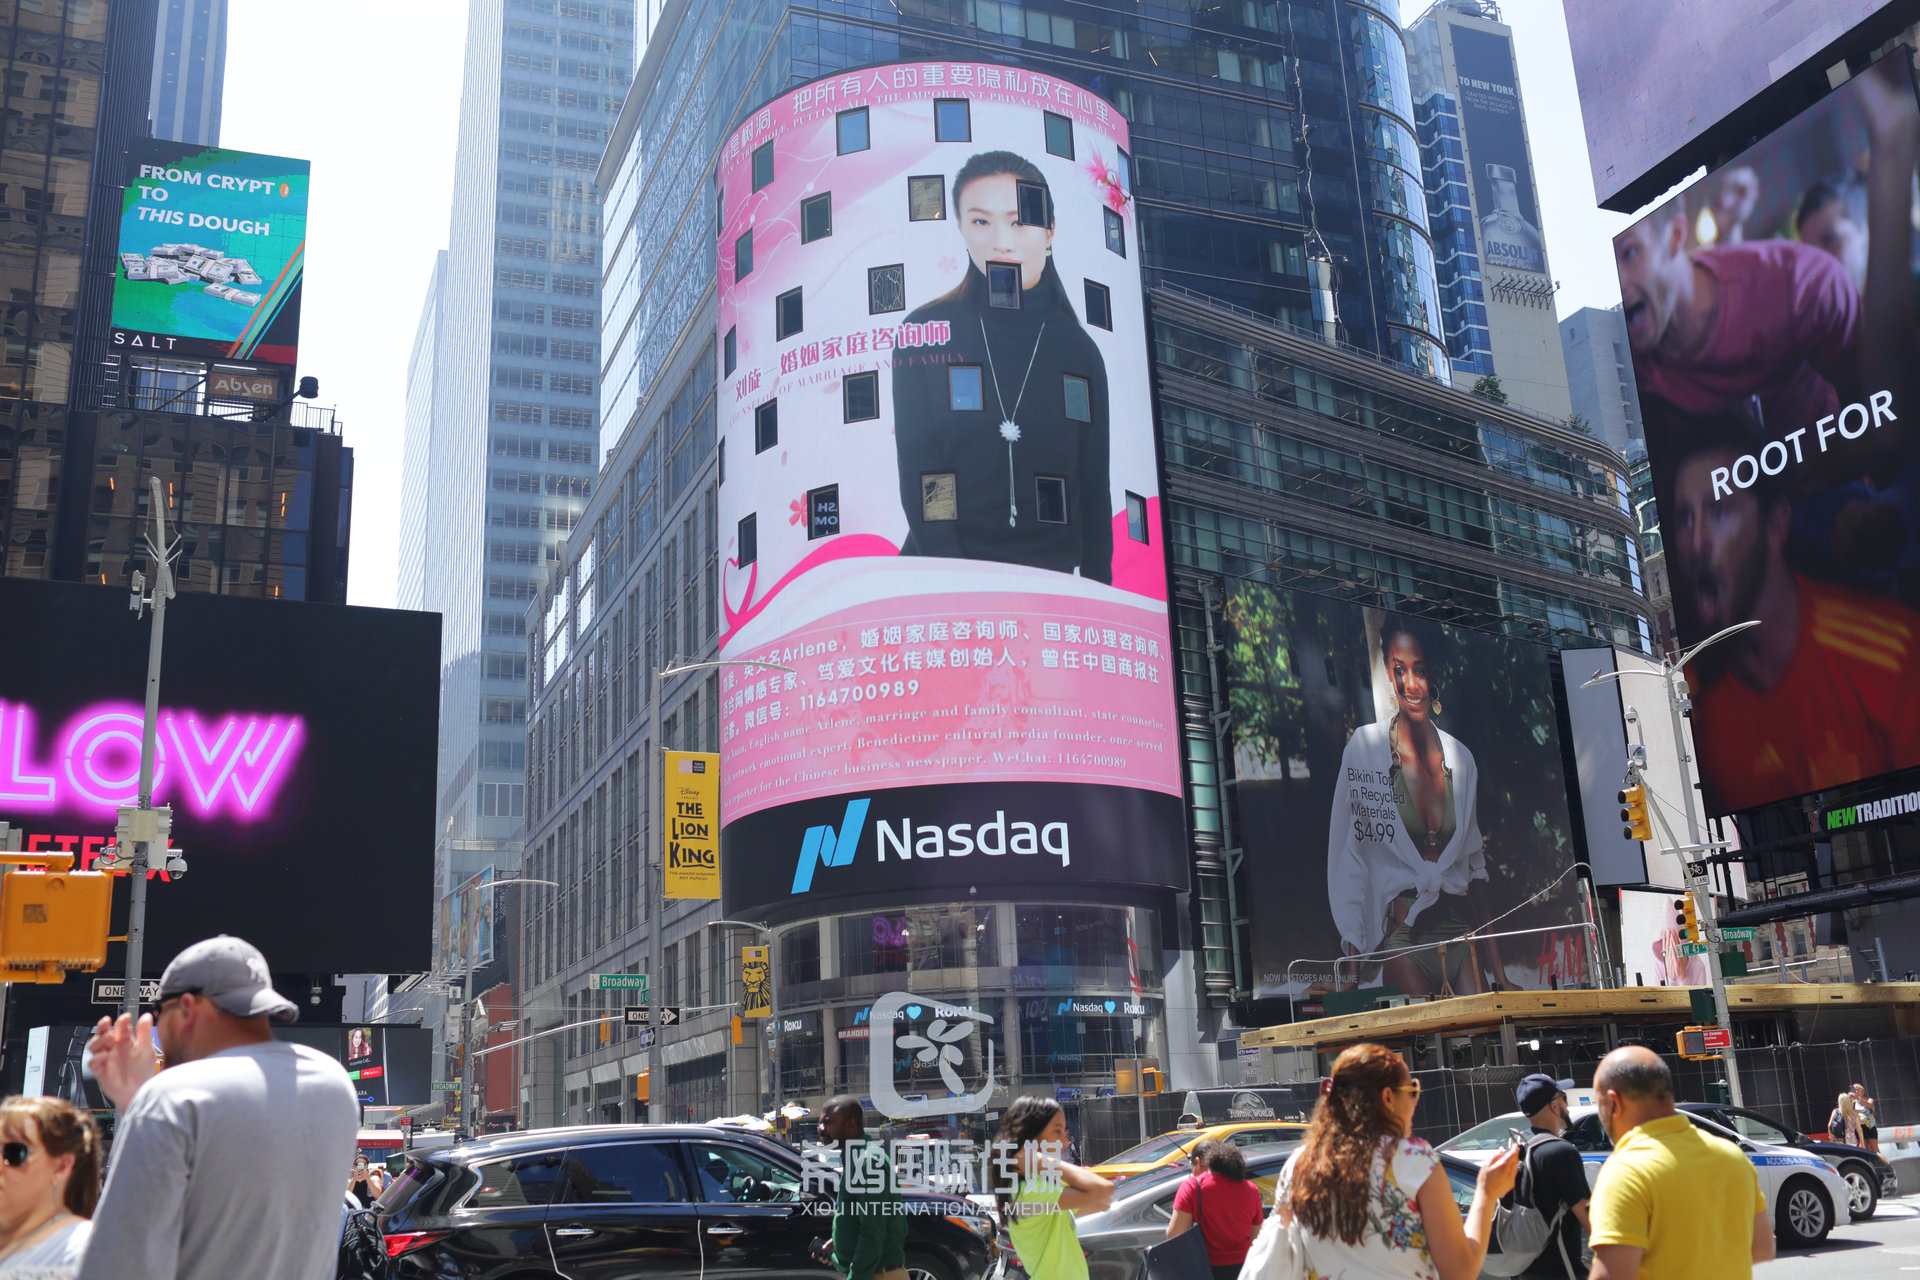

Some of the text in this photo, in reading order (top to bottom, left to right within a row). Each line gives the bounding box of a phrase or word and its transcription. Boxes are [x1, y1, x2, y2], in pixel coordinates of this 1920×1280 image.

[1459, 76, 1470, 87] TO
[1471, 79, 1490, 91] NEW
[793, 104, 842, 128] PUTTING
[876, 92, 902, 103] THE
[907, 90, 985, 101] IMPORTANT
[990, 93, 1043, 109] PRIVACY
[140, 164, 275, 195] FROM CRYPT
[138, 185, 169, 201] TO
[137, 206, 270, 236] THIS DOUGH
[1488, 240, 1532, 261] ABSOL
[779, 382, 793, 395] OF
[799, 364, 867, 387] MARRIAGE
[875, 358, 902, 370] AND
[909, 353, 966, 366] FAMILY
[214, 378, 273, 396] Absen
[1710, 389, 1898, 501] ROOT FOR
[749, 731, 780, 750] English
[784, 726, 810, 739] name
[865, 708, 927, 723] marriage
[933, 704, 958, 718] and
[964, 703, 1007, 719] family
[1091, 710, 1118, 720] state
[759, 747, 806, 769] emotional
[857, 731, 939, 748] Benedictine
[945, 727, 1003, 740] cultural
[1008, 727, 1048, 740] media
[1109, 736, 1133, 746] once
[1136, 739, 1163, 753] served
[760, 781, 772, 792] for
[775, 776, 791, 788] the
[794, 768, 840, 783] Chinese
[844, 760, 901, 775] business
[993, 751, 1052, 763] WeChat:
[1347, 768, 1395, 789] Bikini Top
[1349, 785, 1405, 806] in Recycled
[676, 802, 703, 815] THE
[1351, 802, 1396, 821] Materials
[672, 818, 708, 840] LION
[876, 810, 1071, 868] Nasdaq
[1354, 819, 1395, 843] $4.99
[20, 834, 174, 883] ETFL
[669, 842, 714, 868] KING
[1723, 929, 1752, 940] Broadway
[1683, 944, 1690, 953] W
[602, 976, 645, 989] Broadway
[1263, 973, 1281, 982] NOW
[1290, 973, 1317, 983] STORES
[1319, 974, 1332, 983] AND
[105, 986, 126, 996] ONE
[632, 1012, 672, 1020] ONE AY
[1072, 1001, 1104, 1014] Nasdaq
[838, 1028, 869, 1038] BRANDED
[1253, 1109, 1274, 1118] WORLD
